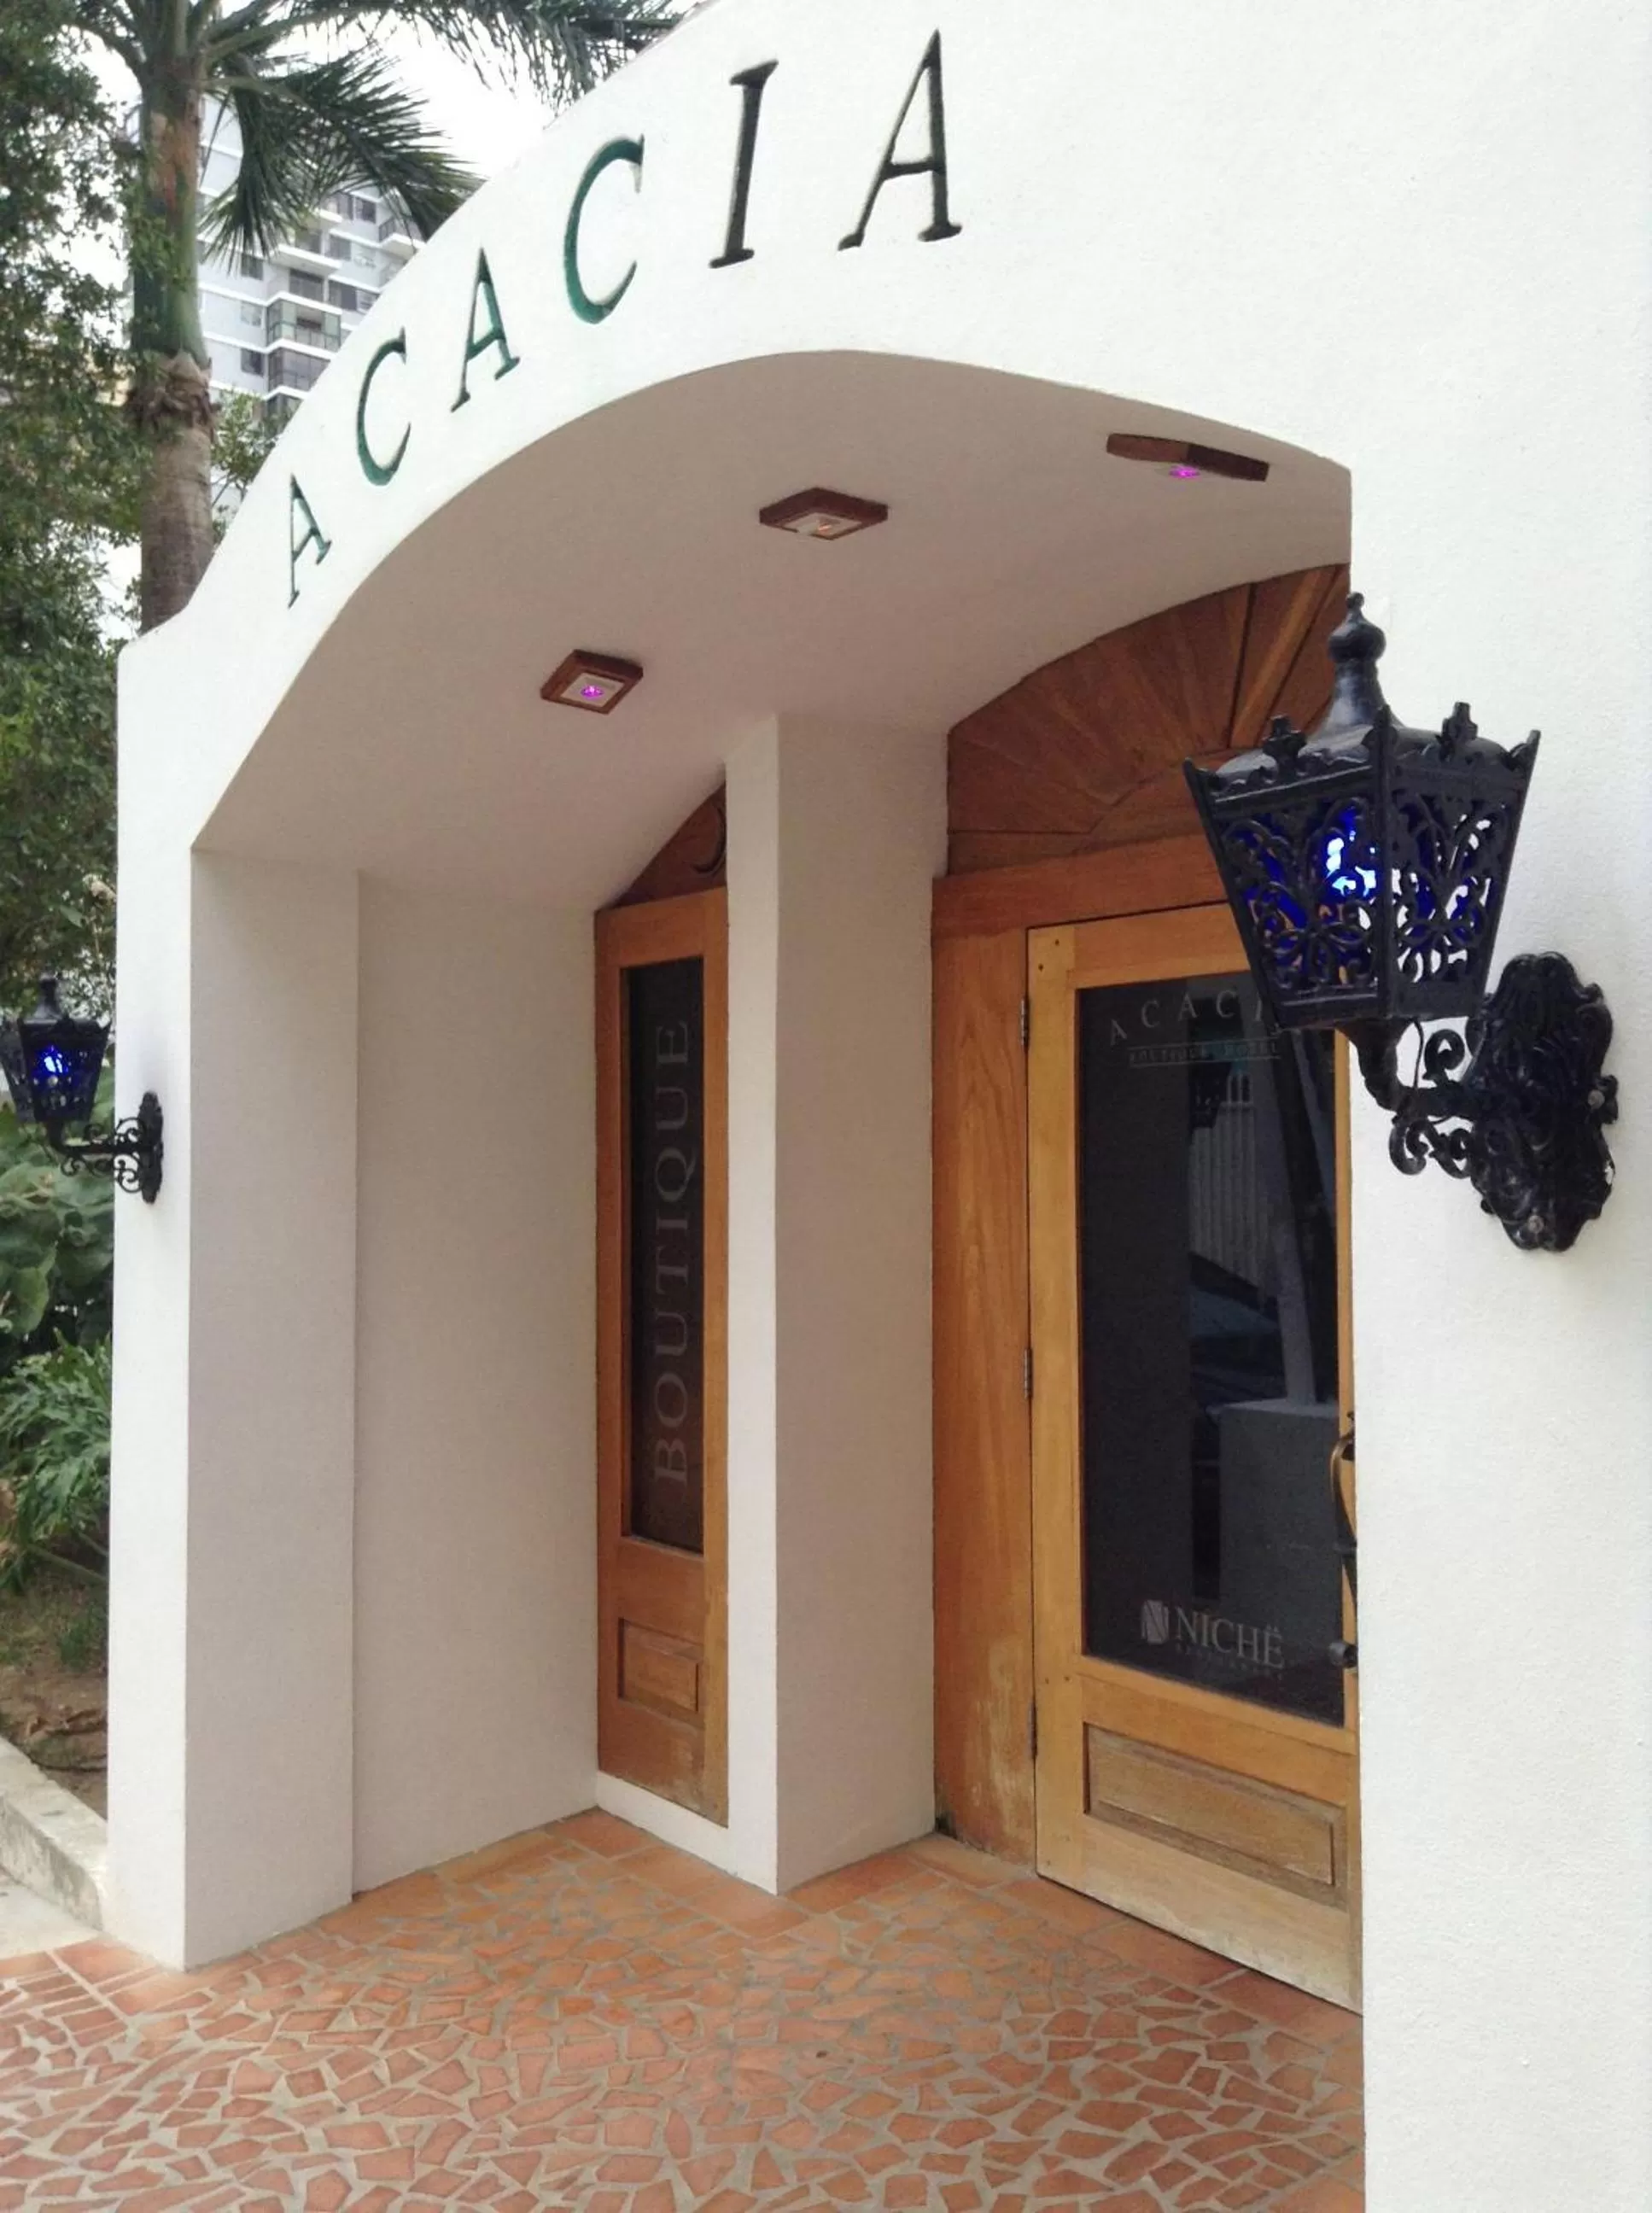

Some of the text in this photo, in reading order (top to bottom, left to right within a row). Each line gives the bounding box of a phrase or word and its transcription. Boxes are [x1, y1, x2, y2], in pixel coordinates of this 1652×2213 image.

[287, 26, 962, 608] ACACIA
[1110, 990, 1264, 1045] ACACI
[654, 1021, 695, 1485] BOUTIQUE
